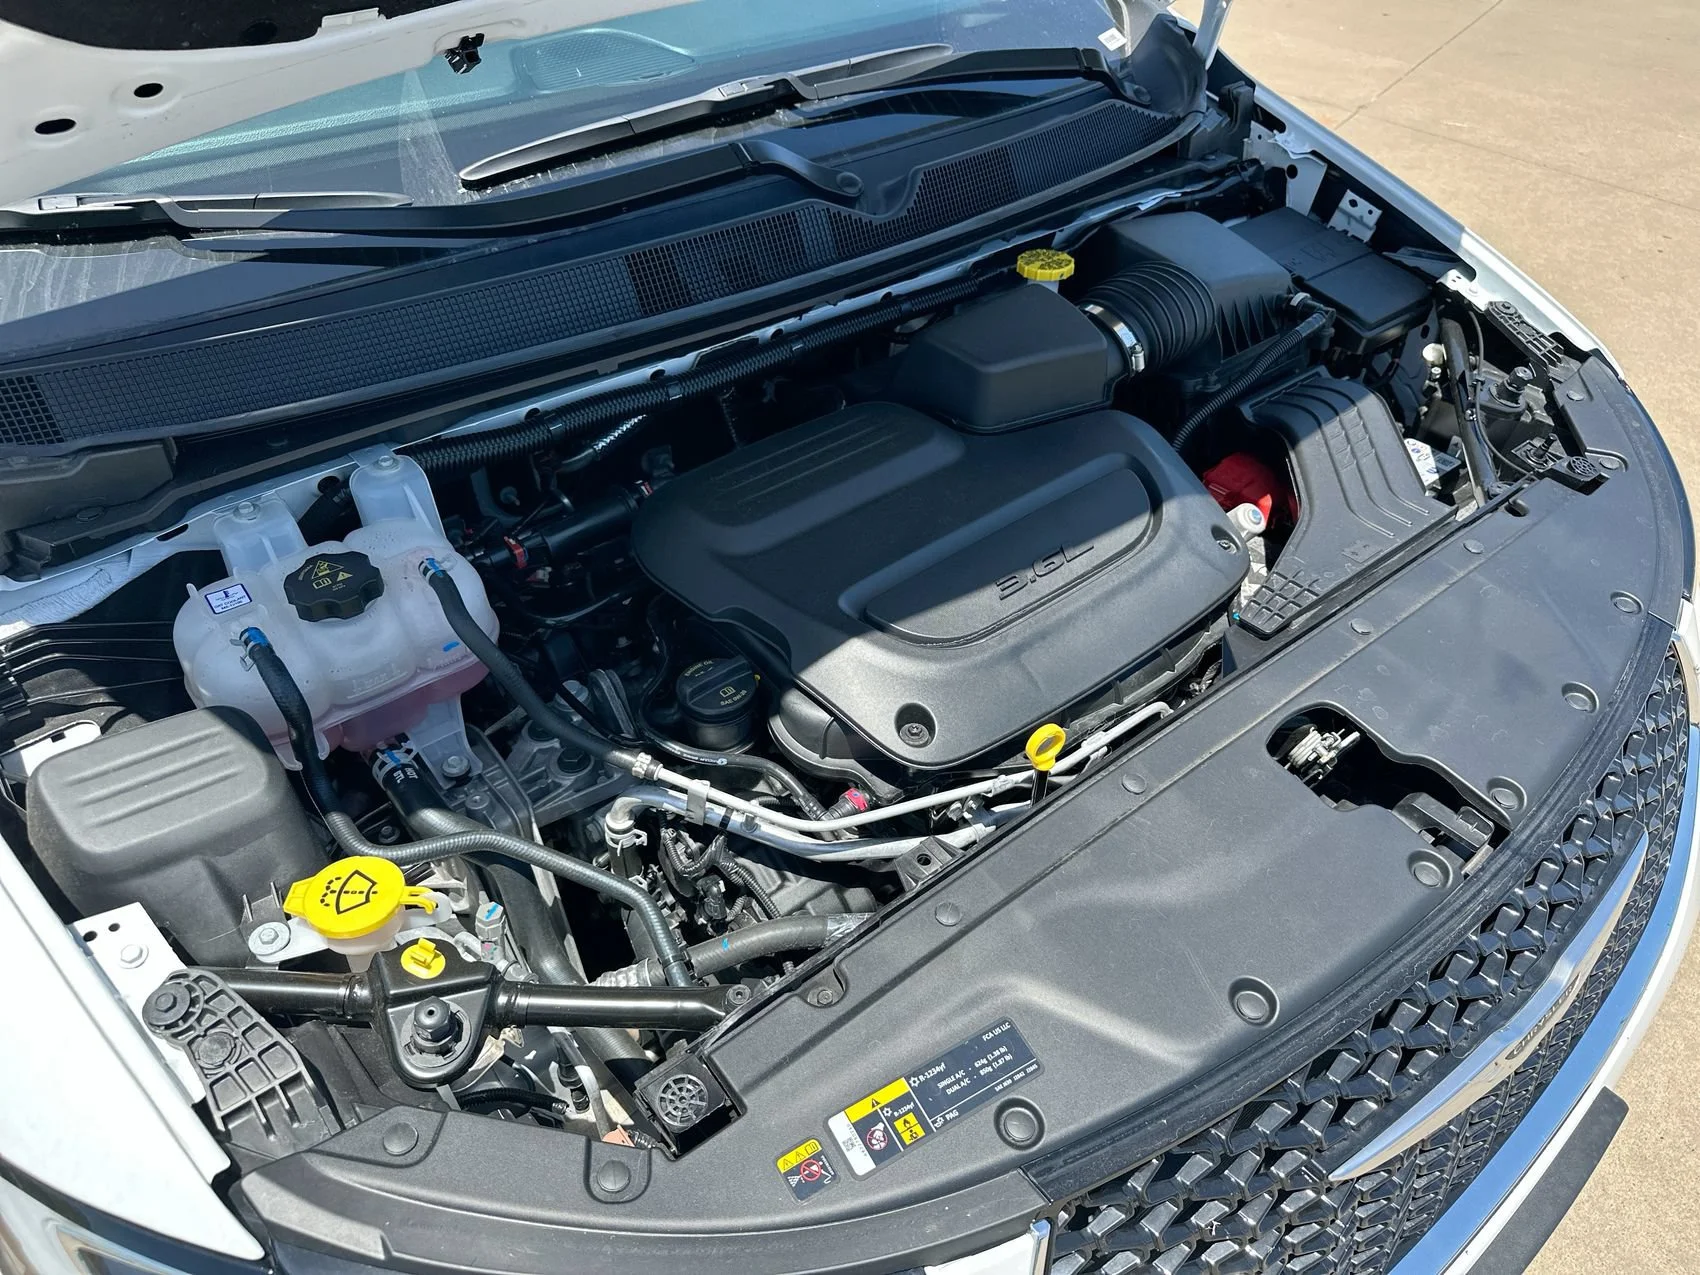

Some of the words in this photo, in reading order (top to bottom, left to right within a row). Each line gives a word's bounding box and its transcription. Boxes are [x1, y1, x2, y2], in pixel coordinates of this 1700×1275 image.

[995, 545, 1095, 601] 3.6L
[1513, 985, 1573, 1055] CHRYSLER
[982, 1031, 995, 1041] FCA
[993, 1027, 1002, 1036] US
[1000, 1022, 1011, 1031] LLC
[918, 1061, 947, 1082] R-1234yf
[937, 1074, 956, 1089] SINGLE
[955, 1069, 966, 1079] A/C
[945, 1083, 961, 1095] DUAL
[960, 1077, 972, 1087] A/C
[945, 1109, 959, 1121] PAG
